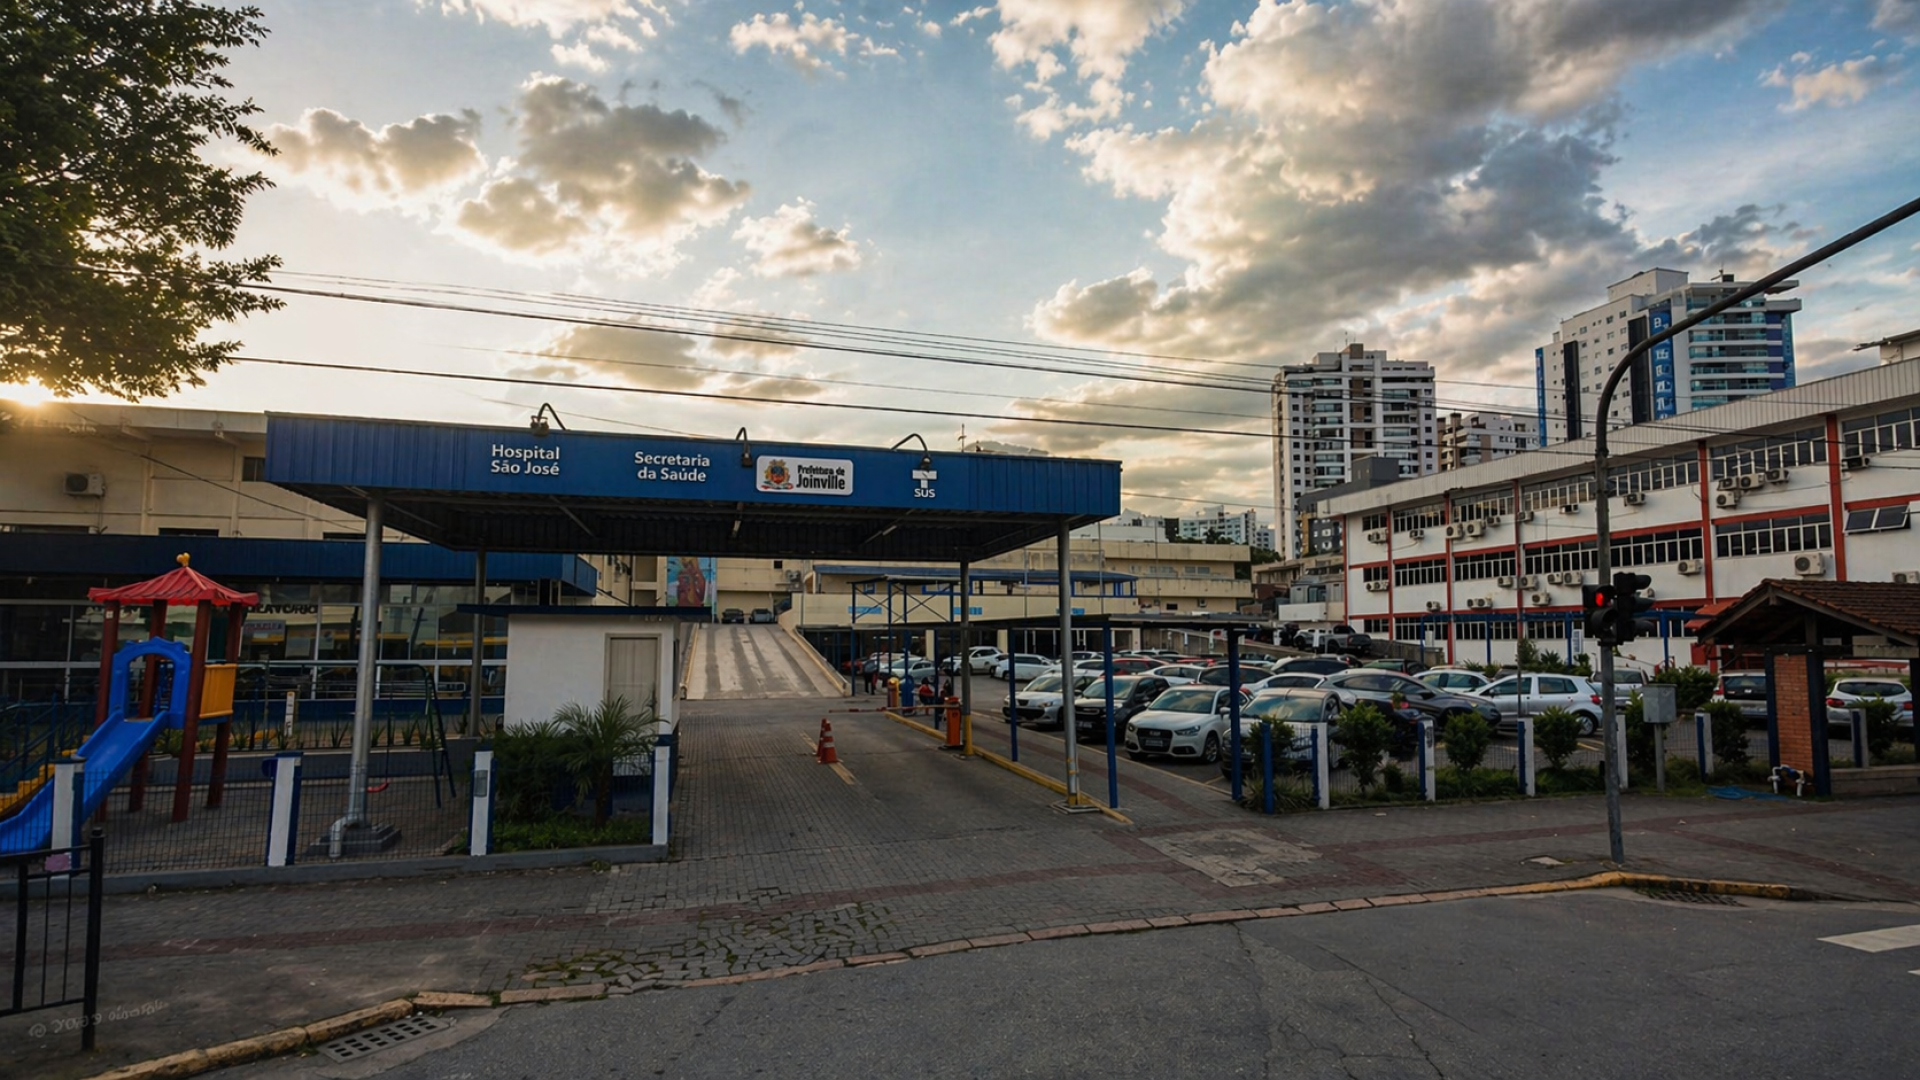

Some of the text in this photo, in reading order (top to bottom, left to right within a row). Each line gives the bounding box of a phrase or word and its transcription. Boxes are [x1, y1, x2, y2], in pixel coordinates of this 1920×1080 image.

[491, 444, 560, 462] Hospital
[634, 451, 710, 467] Secretaria
[491, 460, 560, 475] São José
[637, 466, 707, 482] da Saúde
[835, 466, 845, 476] de
[796, 474, 845, 490] Joinville
[914, 488, 935, 498] SUS
